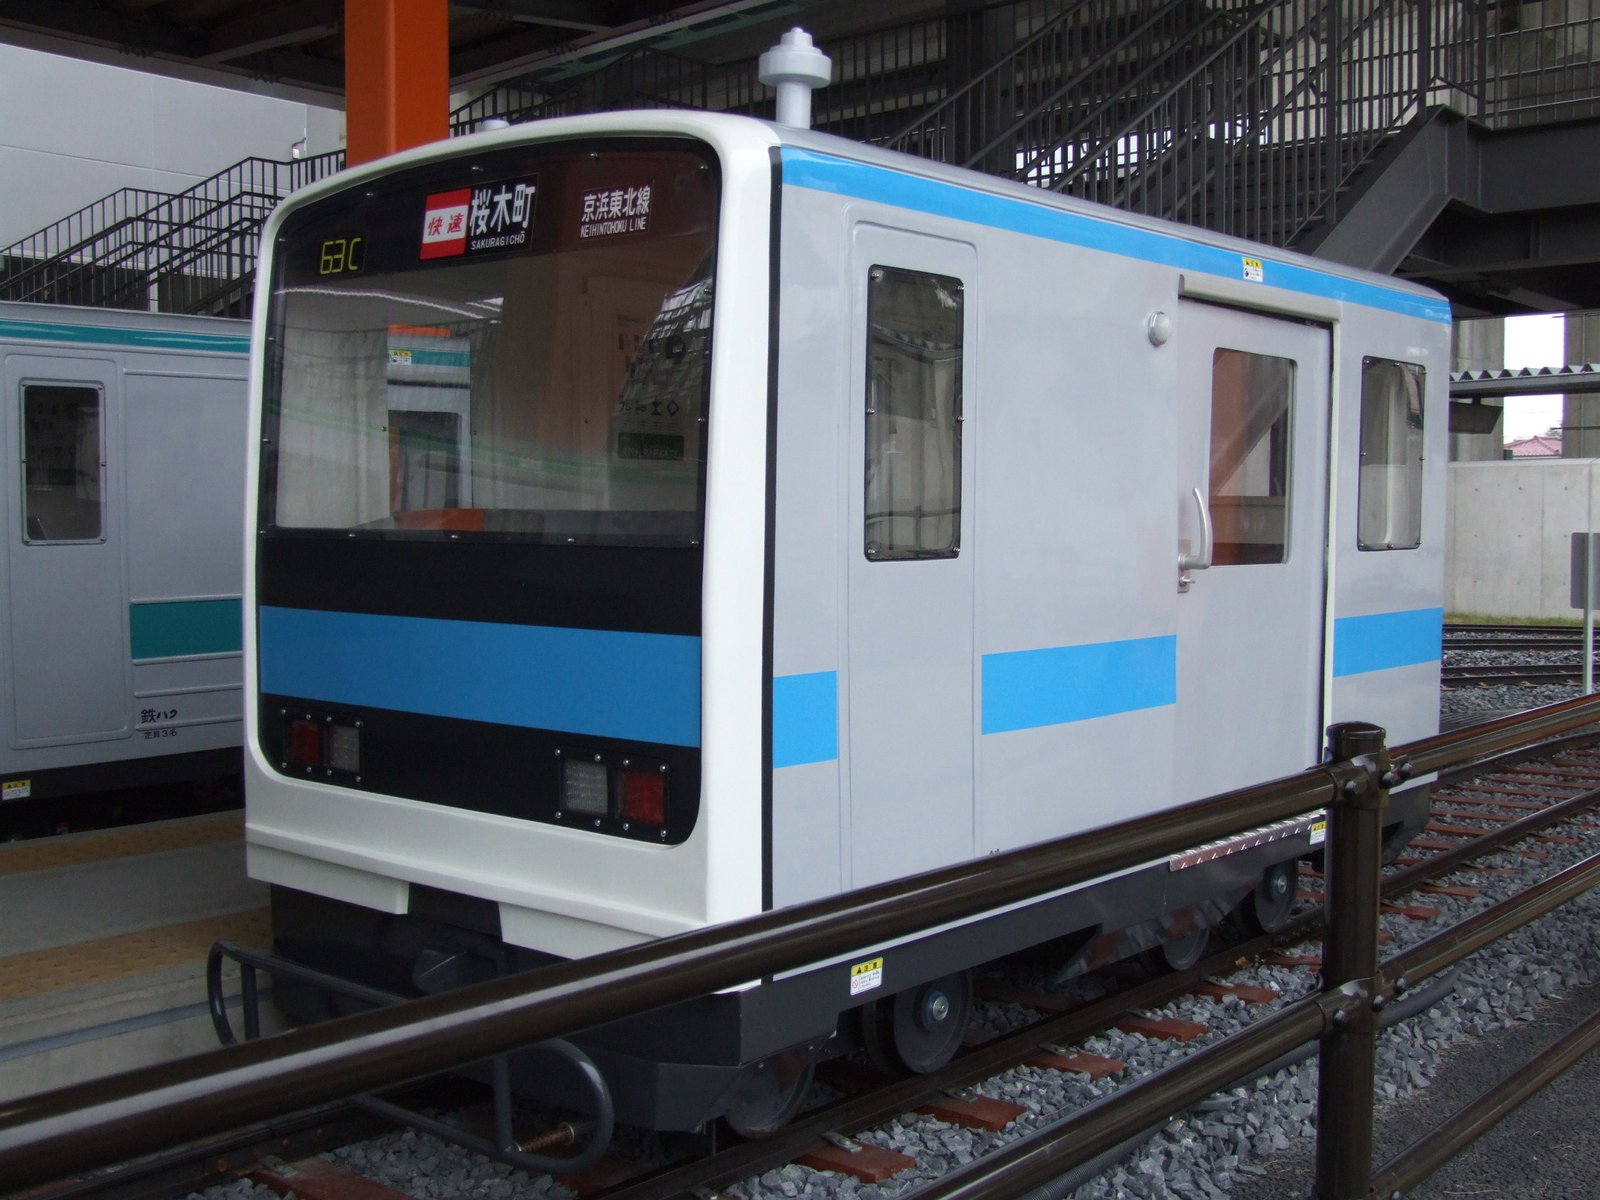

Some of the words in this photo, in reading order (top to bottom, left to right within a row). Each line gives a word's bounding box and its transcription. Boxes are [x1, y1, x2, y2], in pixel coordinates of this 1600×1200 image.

[469, 183, 536, 236] 桜木町
[581, 185, 651, 223] 京浜東北線
[427, 212, 465, 236] 快速
[629, 216, 647, 232] LINE
[319, 237, 362, 276] 63C
[141, 707, 178, 724] 鉄ハク
